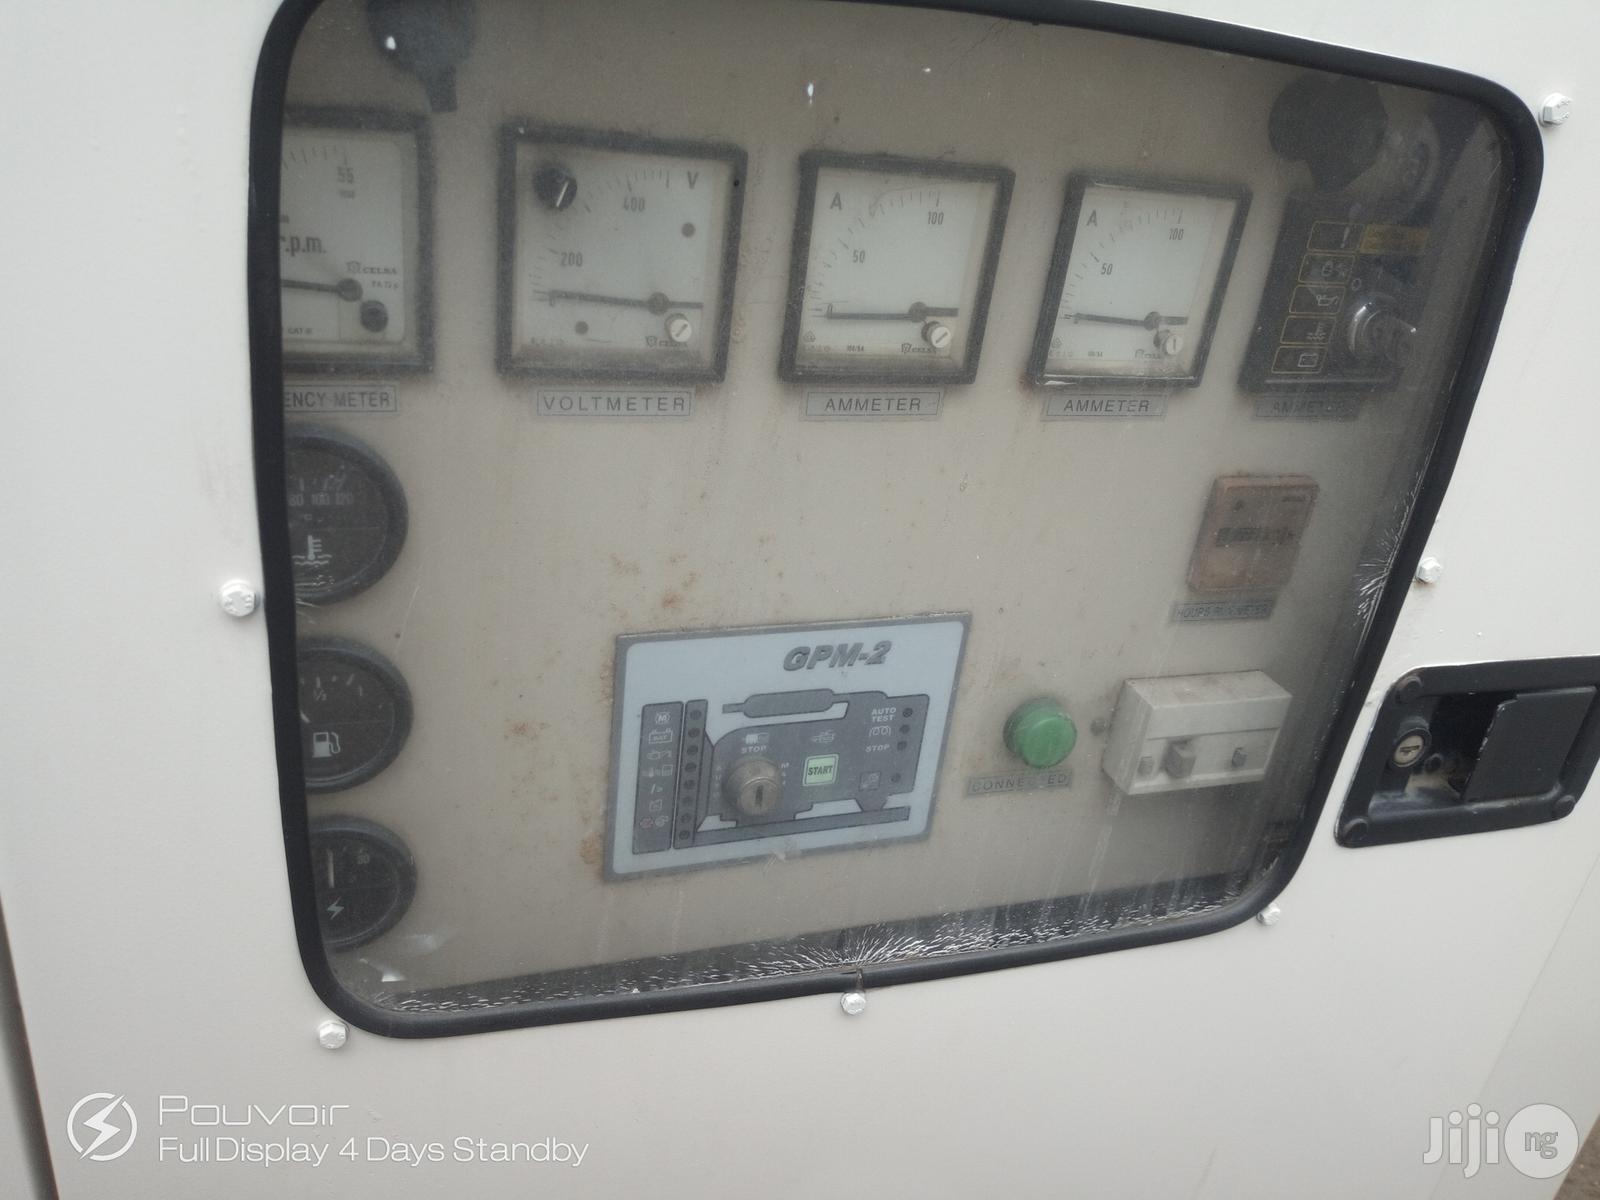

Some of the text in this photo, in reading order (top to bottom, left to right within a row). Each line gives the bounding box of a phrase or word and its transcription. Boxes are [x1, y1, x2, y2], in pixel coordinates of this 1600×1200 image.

[687, 171, 699, 190] V
[623, 196, 646, 213] 400
[829, 192, 843, 210] A
[927, 210, 945, 226] 100
[1086, 209, 1098, 227] A
[1168, 228, 1185, 242] 100
[560, 252, 584, 268] 200
[852, 249, 866, 264] 50
[1101, 262, 1114, 277] 50
[333, 392, 390, 408] METER
[543, 396, 686, 412] VOLTMETER
[824, 398, 922, 412] AMMETER
[1063, 399, 1150, 413] AMMETER
[783, 640, 893, 672] GPM-2
[871, 706, 897, 716] AUTO
[871, 714, 895, 723] TEST
[740, 745, 767, 755] STOP
[864, 743, 890, 753] STOP
[807, 765, 834, 776] START
[971, 774, 1068, 793] CONNECED
